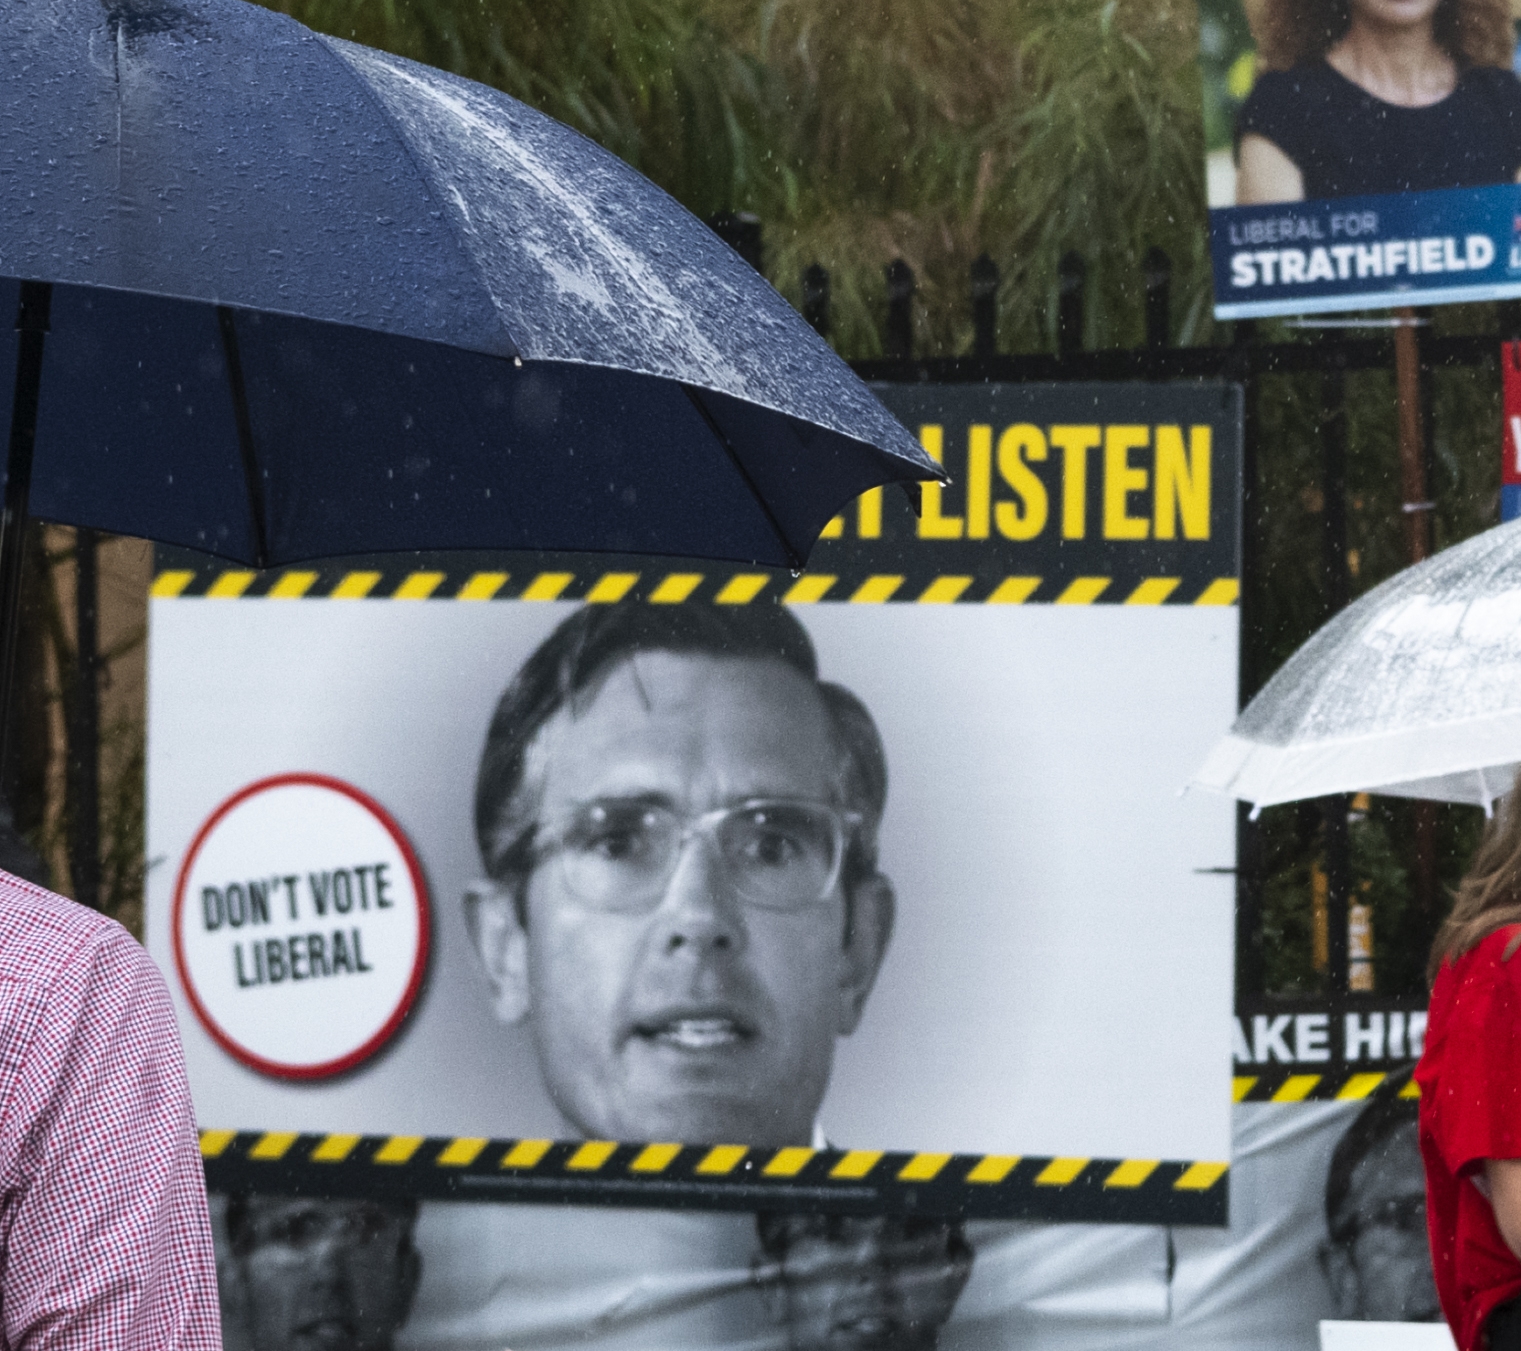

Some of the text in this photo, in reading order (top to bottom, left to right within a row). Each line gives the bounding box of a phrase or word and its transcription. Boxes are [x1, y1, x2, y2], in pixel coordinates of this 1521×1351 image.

[1229, 210, 1378, 247] LIBERAL FOR
[1231, 235, 1494, 287] STRATHFIELD
[917, 422, 1213, 541] LISTEN
[202, 861, 394, 932] DON'T VOTE
[233, 927, 374, 989] LIBERAL
